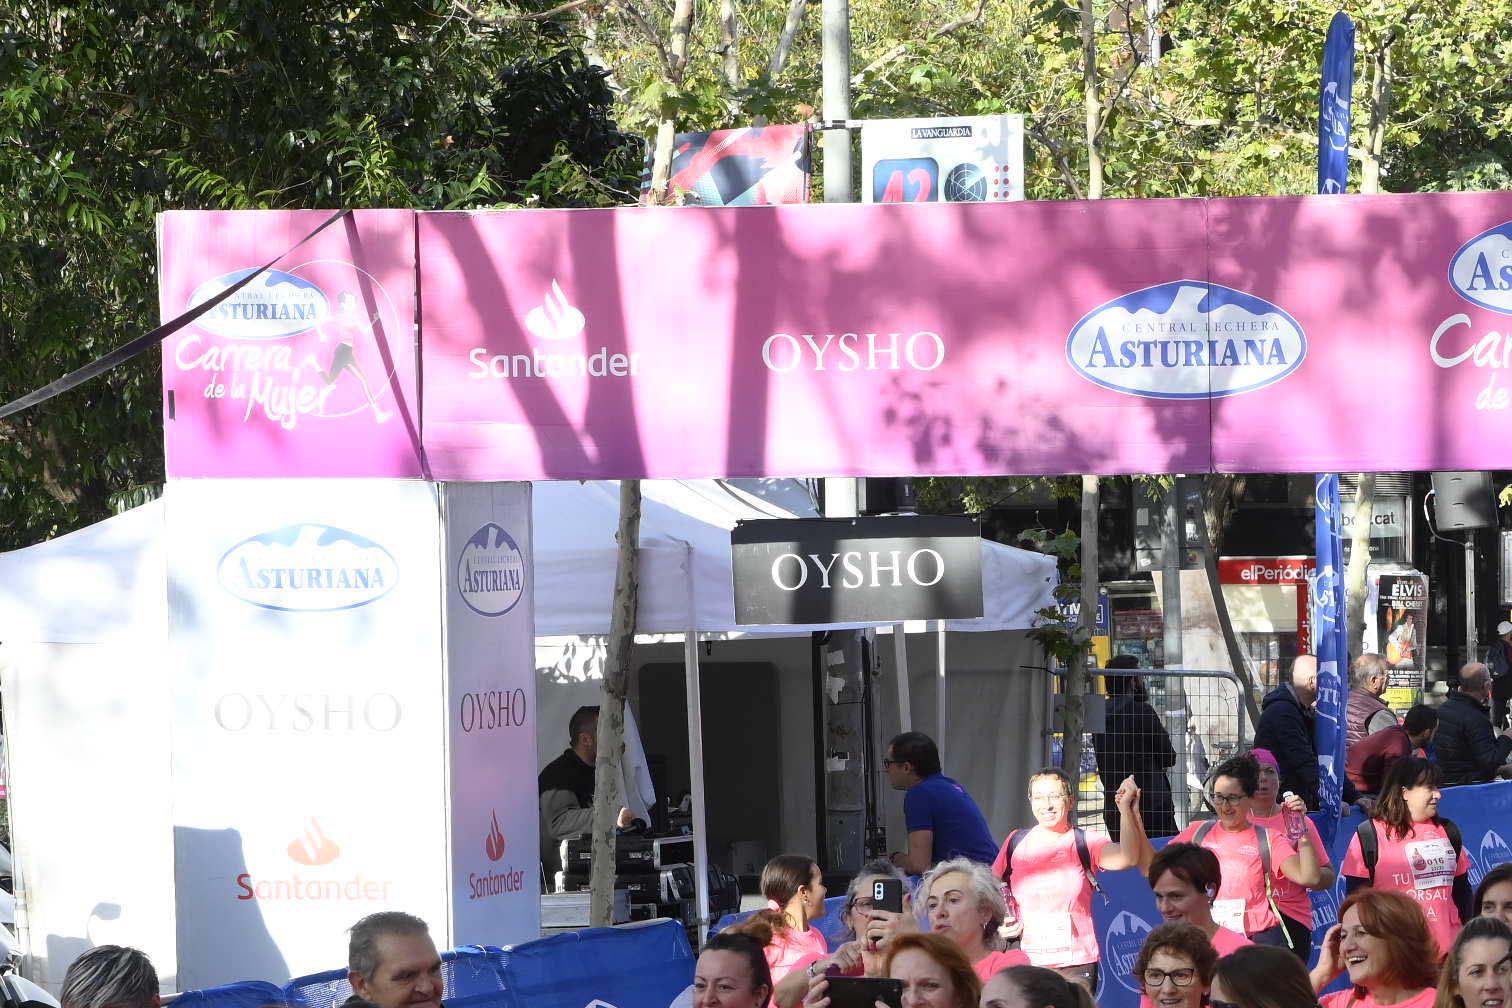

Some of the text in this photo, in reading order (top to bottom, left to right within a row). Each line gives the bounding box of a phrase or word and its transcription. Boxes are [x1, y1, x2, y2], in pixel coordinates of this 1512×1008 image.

[922, 127, 971, 137] VANGUARDIA
[204, 303, 316, 320] STURIANA
[1122, 320, 1280, 333] CENTRAL LECHERA
[176, 335, 292, 371] Carrera
[469, 347, 638, 377] Santander
[762, 331, 945, 373] OYSHO
[1085, 326, 1288, 368] ASTURIANA
[204, 365, 336, 430] de la Mujer
[1476, 372, 1508, 410] de
[238, 556, 385, 590] ASTURIANA
[463, 558, 520, 592] ASTURIANA
[771, 549, 945, 591] OYSHO
[1392, 584, 1422, 596] ELVIS
[214, 691, 403, 733] OYSHO
[461, 687, 526, 733] OYSHO
[237, 873, 392, 901] Santander
[469, 868, 525, 900] Santander
[1392, 873, 1409, 886] TU
